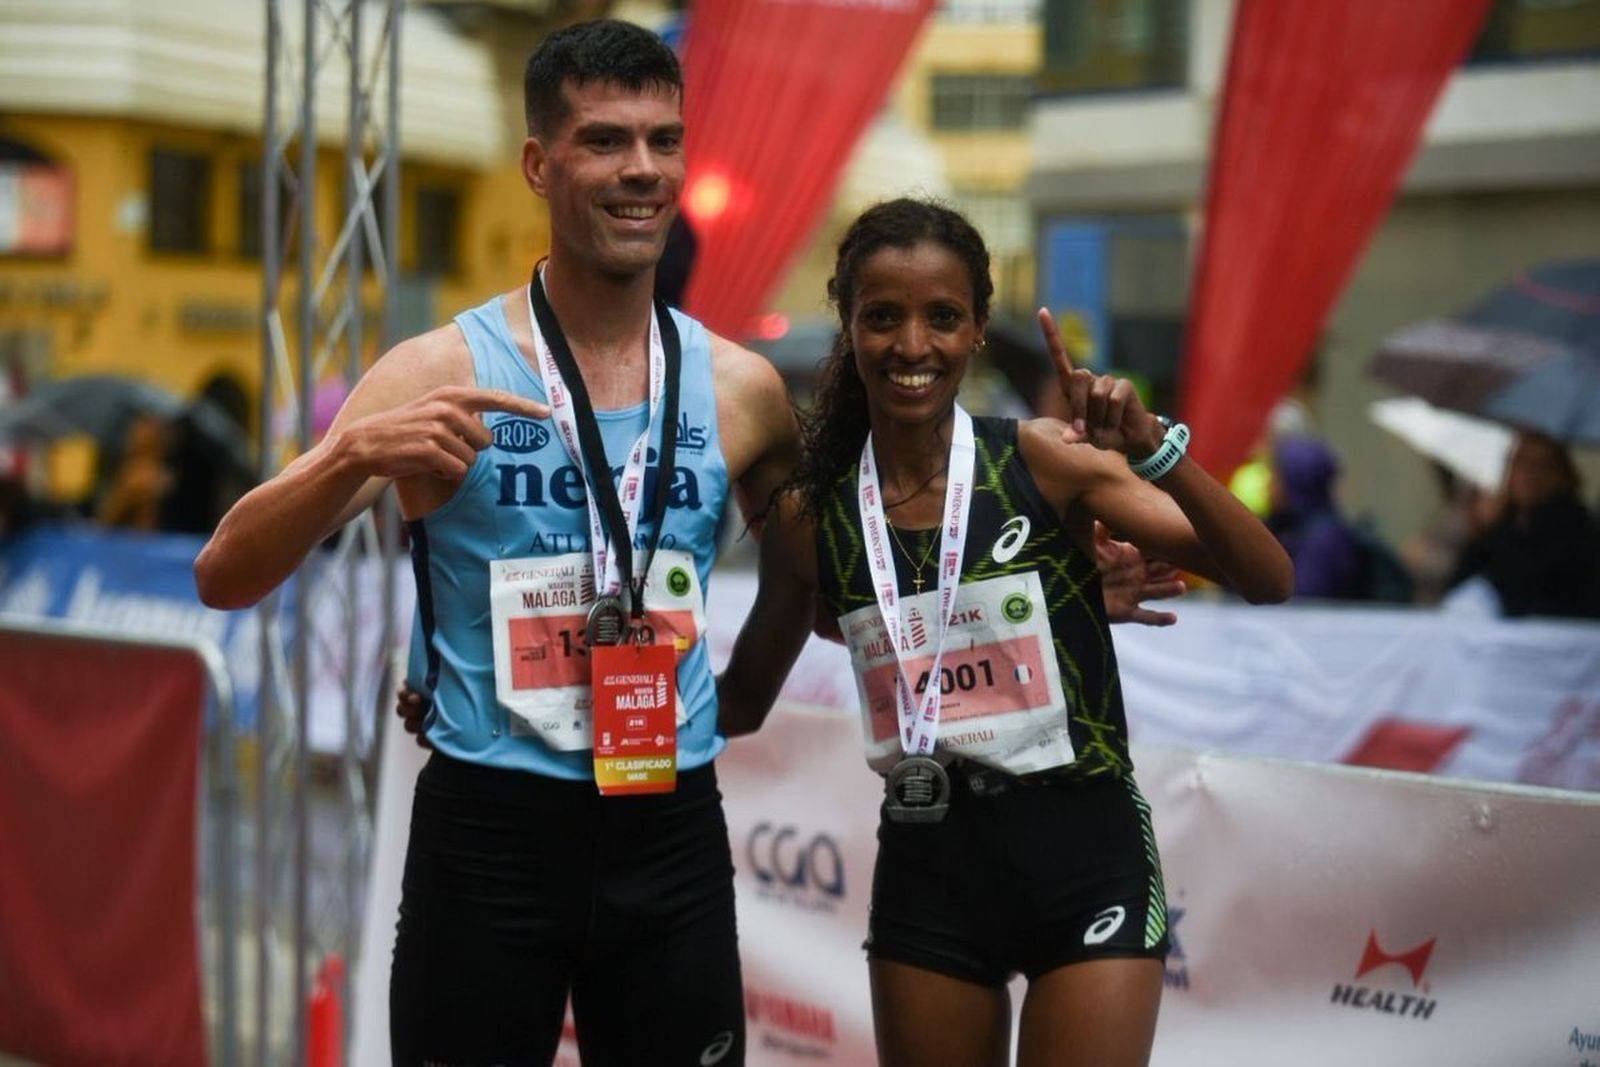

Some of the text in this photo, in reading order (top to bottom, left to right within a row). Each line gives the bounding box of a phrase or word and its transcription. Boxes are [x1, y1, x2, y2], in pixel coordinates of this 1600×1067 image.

[492, 422, 546, 447] TROPS
[522, 589, 577, 609] MÁLAGA
[948, 608, 982, 627] 21K
[616, 692, 656, 711] MÁLAGA
[615, 758, 673, 771] CLASIFICADO
[1330, 983, 1437, 1020] HEALTH
